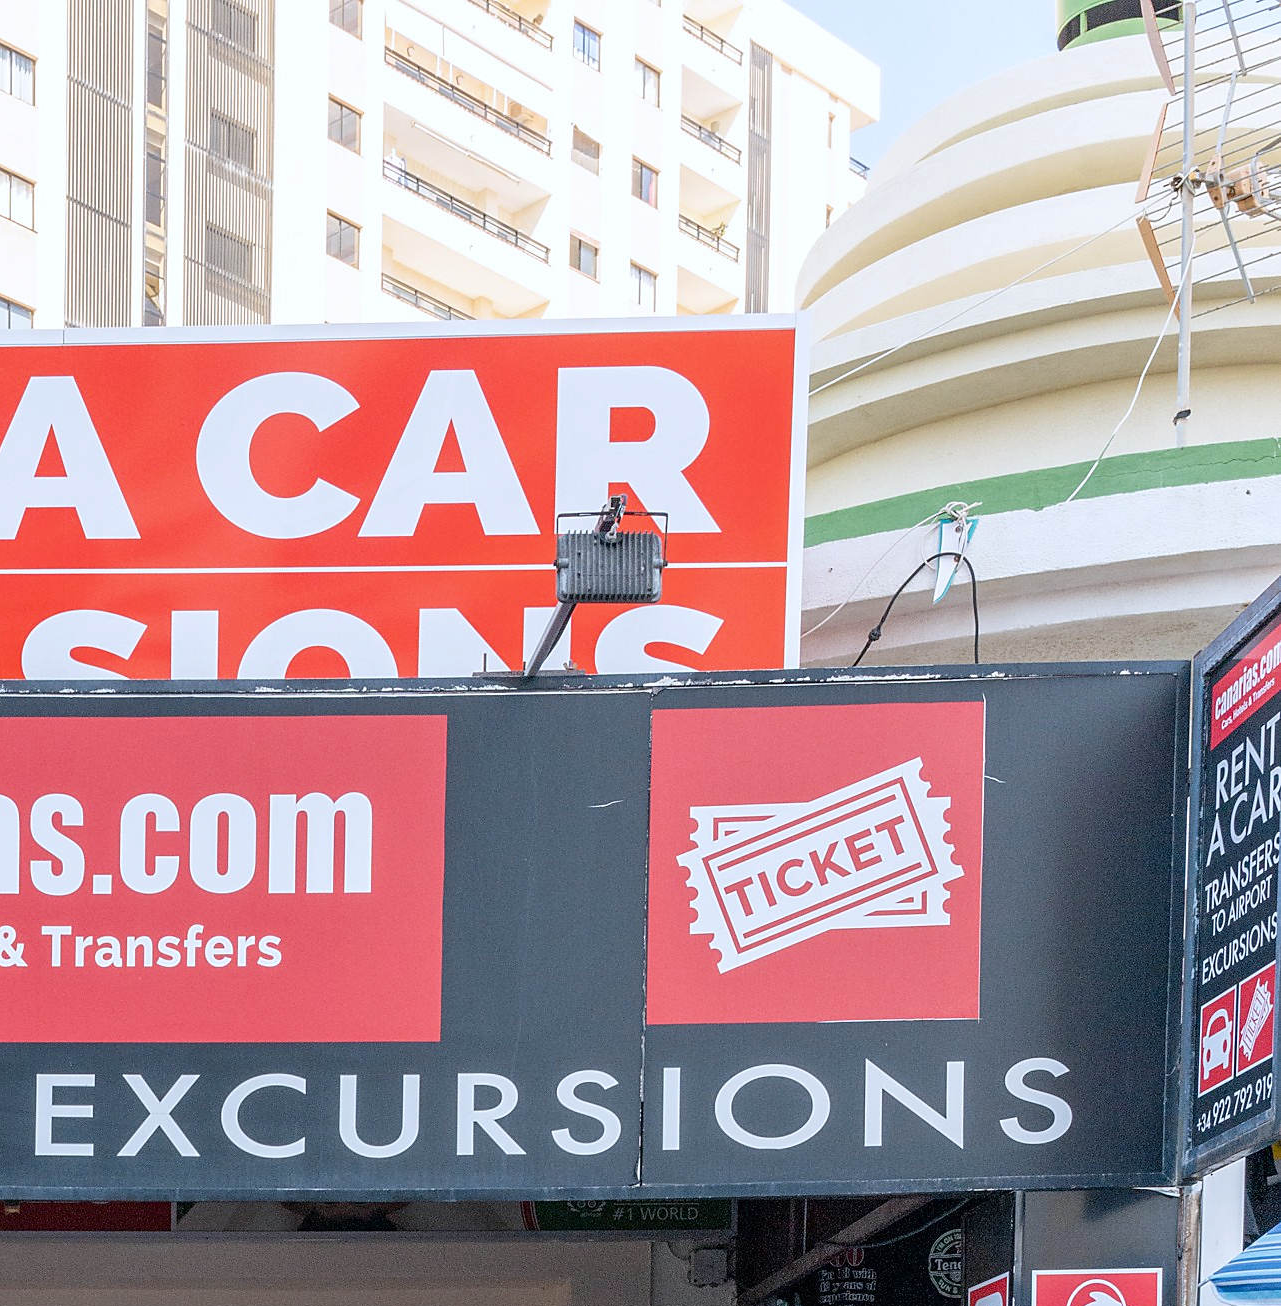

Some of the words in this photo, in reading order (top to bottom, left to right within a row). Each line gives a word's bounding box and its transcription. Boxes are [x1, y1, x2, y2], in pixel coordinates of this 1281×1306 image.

[196, 366, 721, 540] CAR
[1216, 711, 1281, 810] RENT
[725, 816, 906, 917] TICKET
[1204, 832, 1280, 913] TRANSFERS
[1206, 812, 1226, 868] A
[1211, 911, 1226, 937] TO
[1228, 874, 1272, 927] AIRPORT
[42, 924, 282, 968] Transfers
[1202, 911, 1277, 985] EXCURSIONS
[36, 1057, 1073, 1159] EXCURSIONS
[1212, 1095, 1231, 1126] 922
[1234, 1084, 1254, 1114] 792
[1255, 1072, 1273, 1102] 919
[640, 1207, 699, 1221] WORLD
